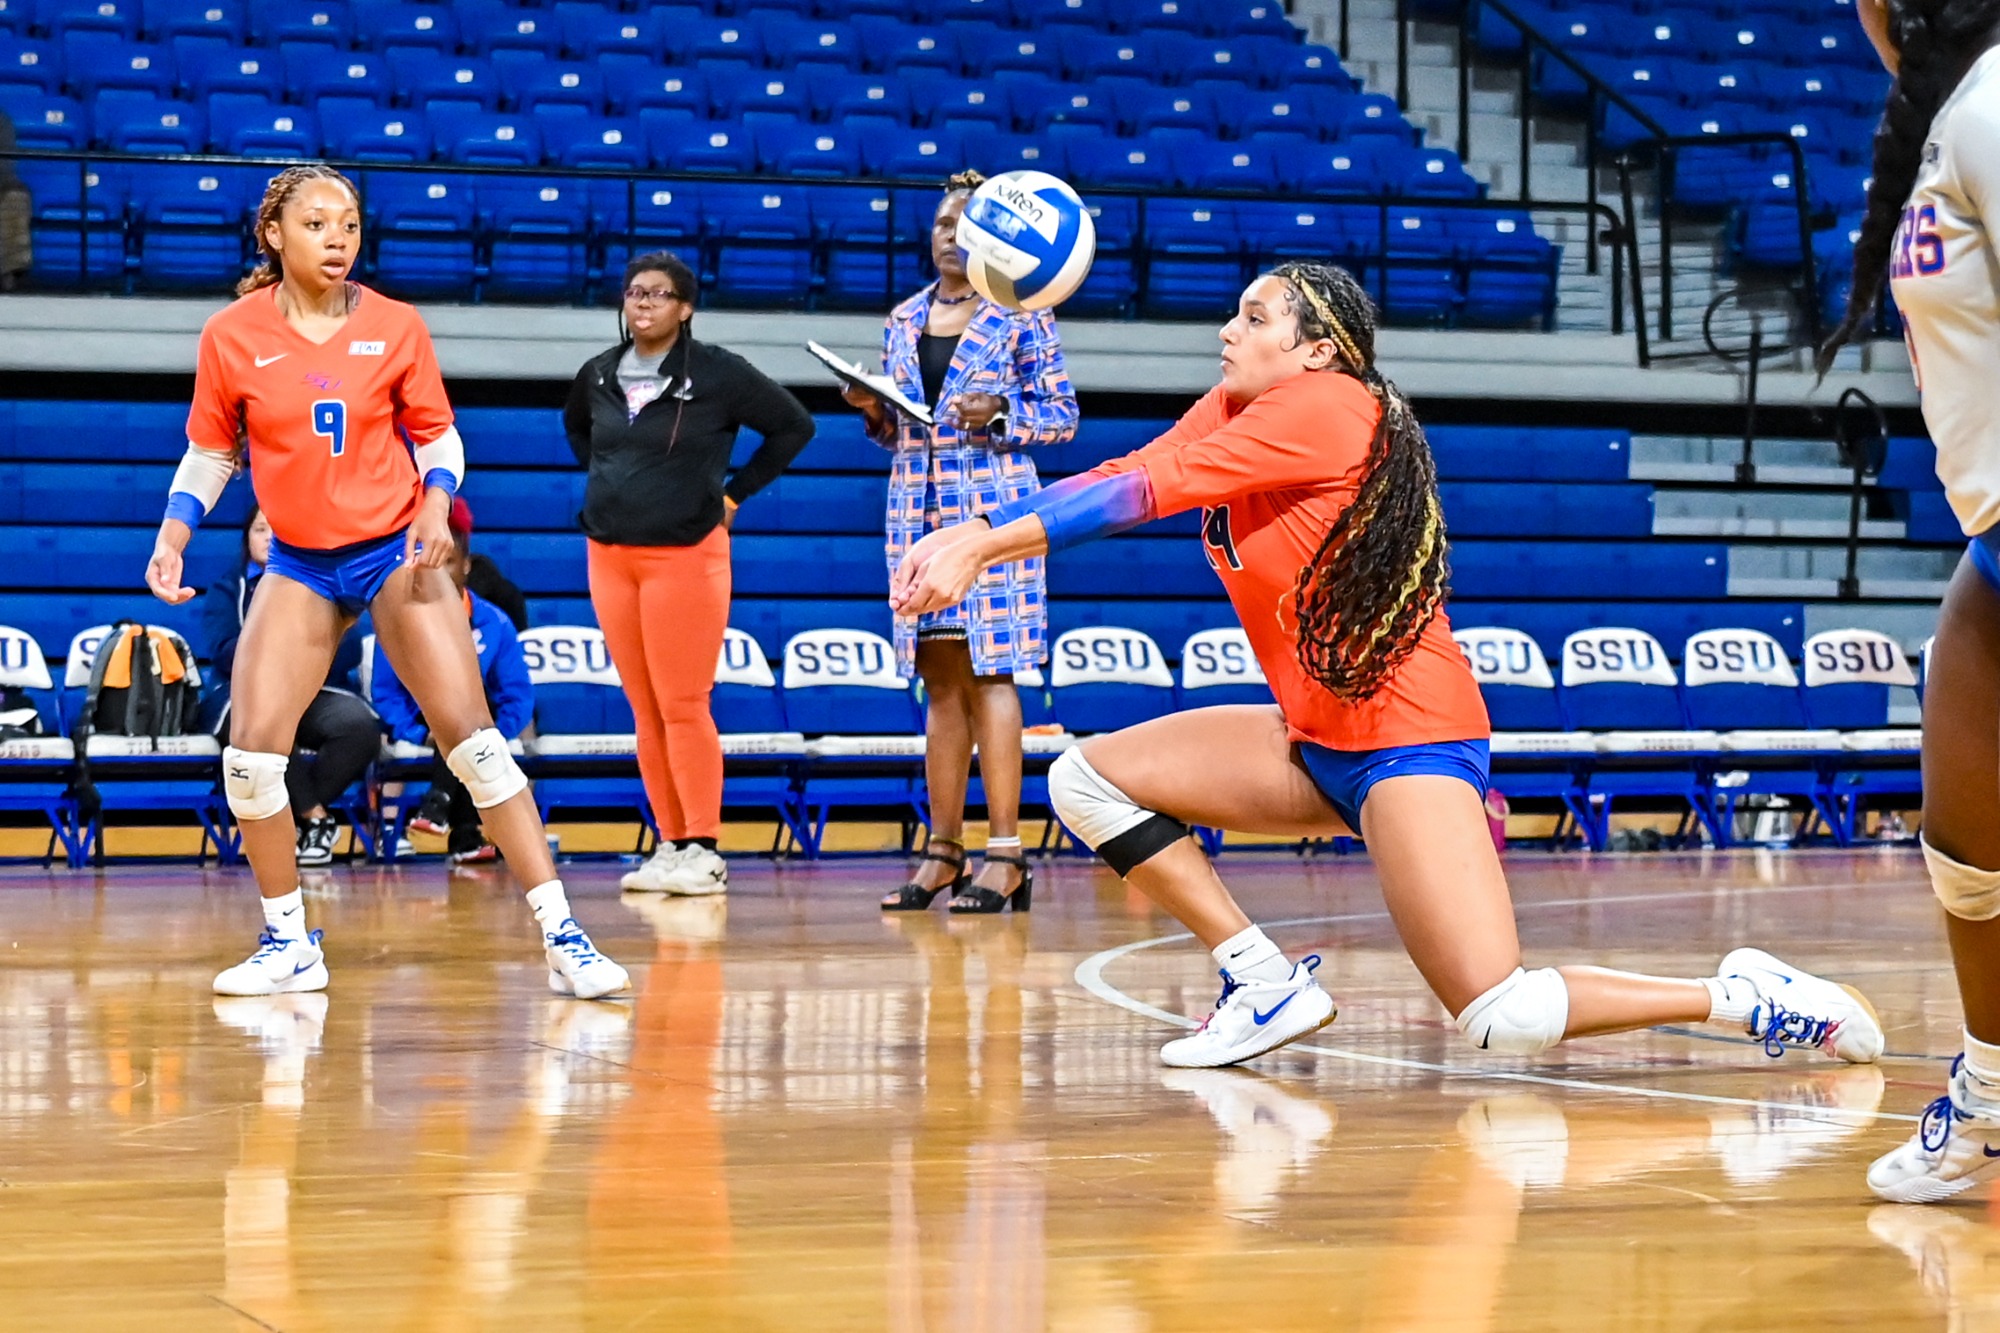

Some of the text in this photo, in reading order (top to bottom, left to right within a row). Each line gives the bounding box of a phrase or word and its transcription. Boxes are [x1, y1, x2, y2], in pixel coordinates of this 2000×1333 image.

[311, 398, 348, 457] 9
[793, 641, 884, 676] SSU
[1061, 638, 1150, 672] SSU
[1192, 641, 1263, 675] SS
[1571, 639, 1655, 672] SSU
[1694, 640, 1776, 673] SSU
[1812, 640, 1895, 673] SSU
